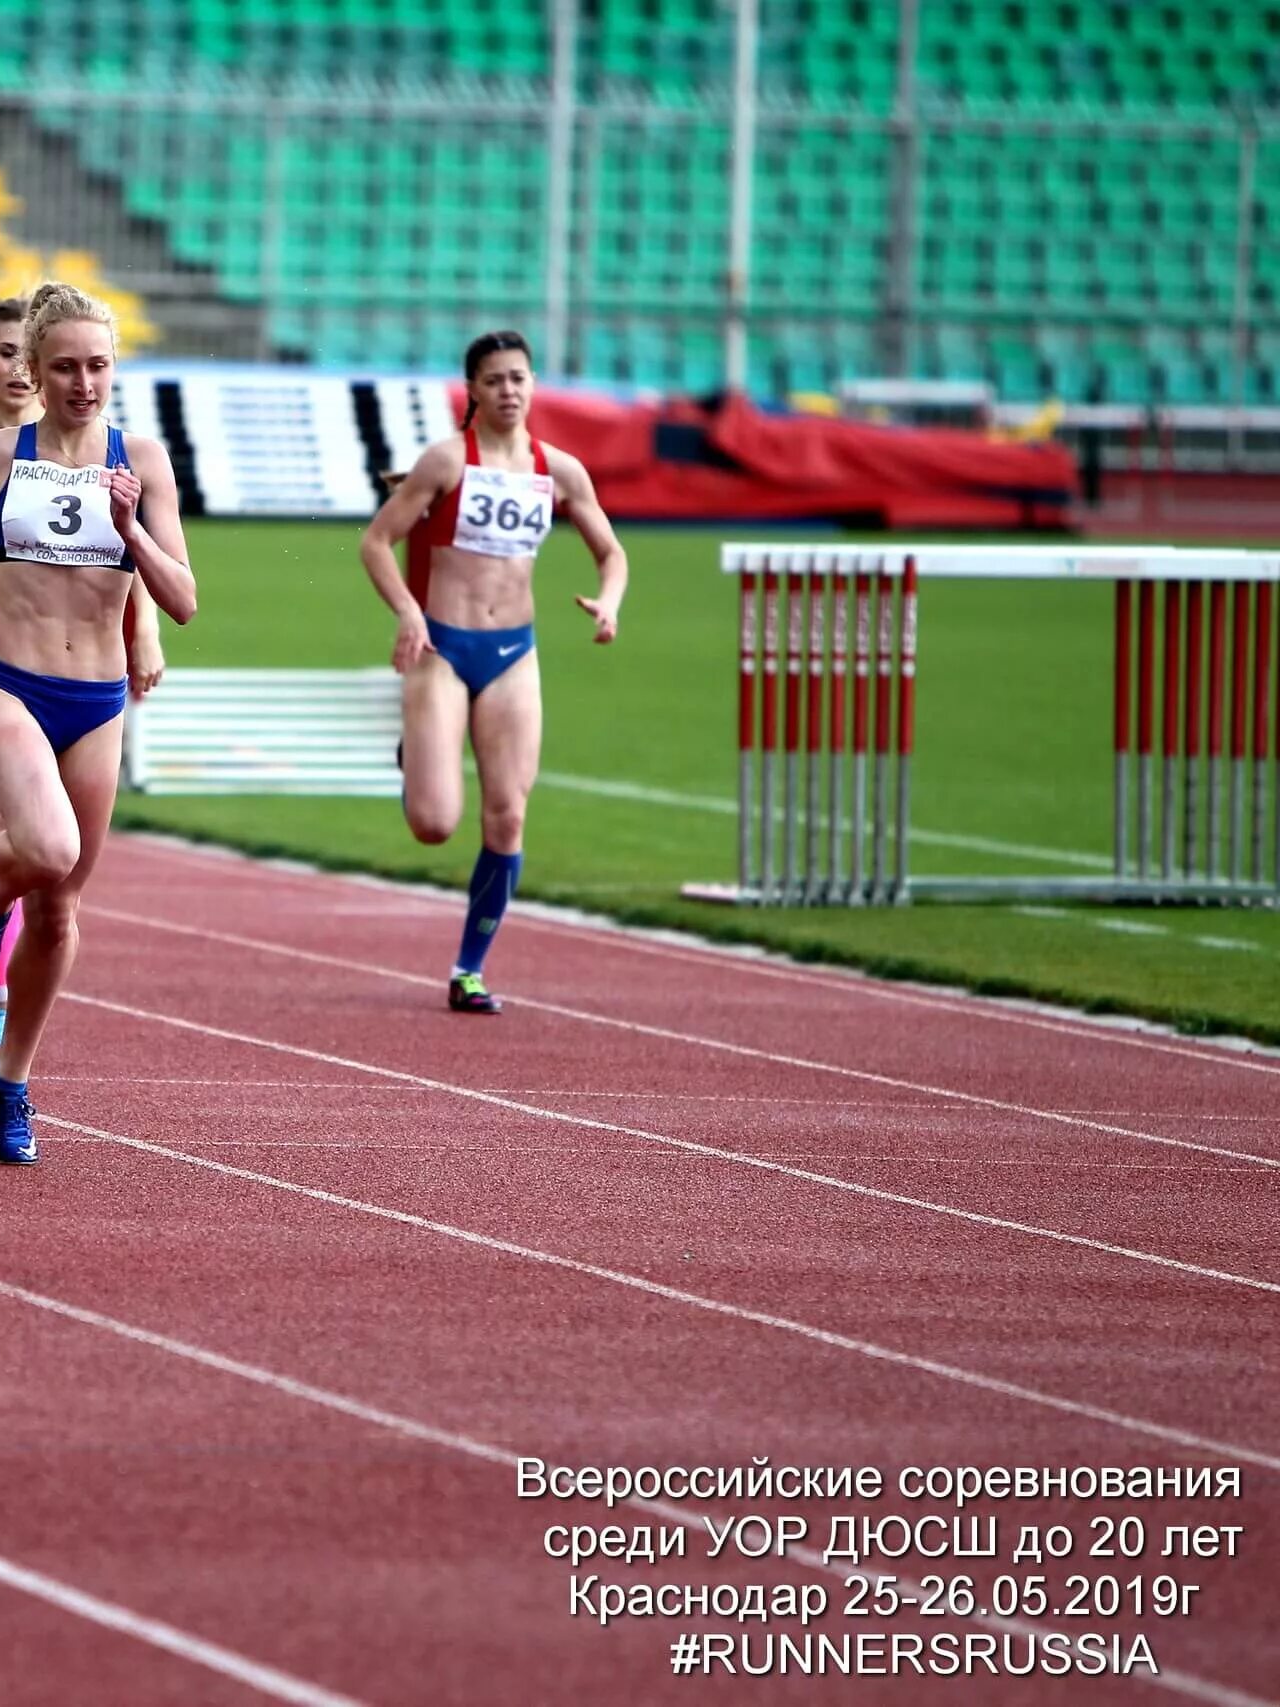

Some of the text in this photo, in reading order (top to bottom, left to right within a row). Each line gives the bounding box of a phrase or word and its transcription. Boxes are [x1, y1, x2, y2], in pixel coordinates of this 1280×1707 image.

[13, 465, 99, 488] КРАСНОДАР'19
[47, 495, 82, 535] 3
[466, 493, 546, 534] 364
